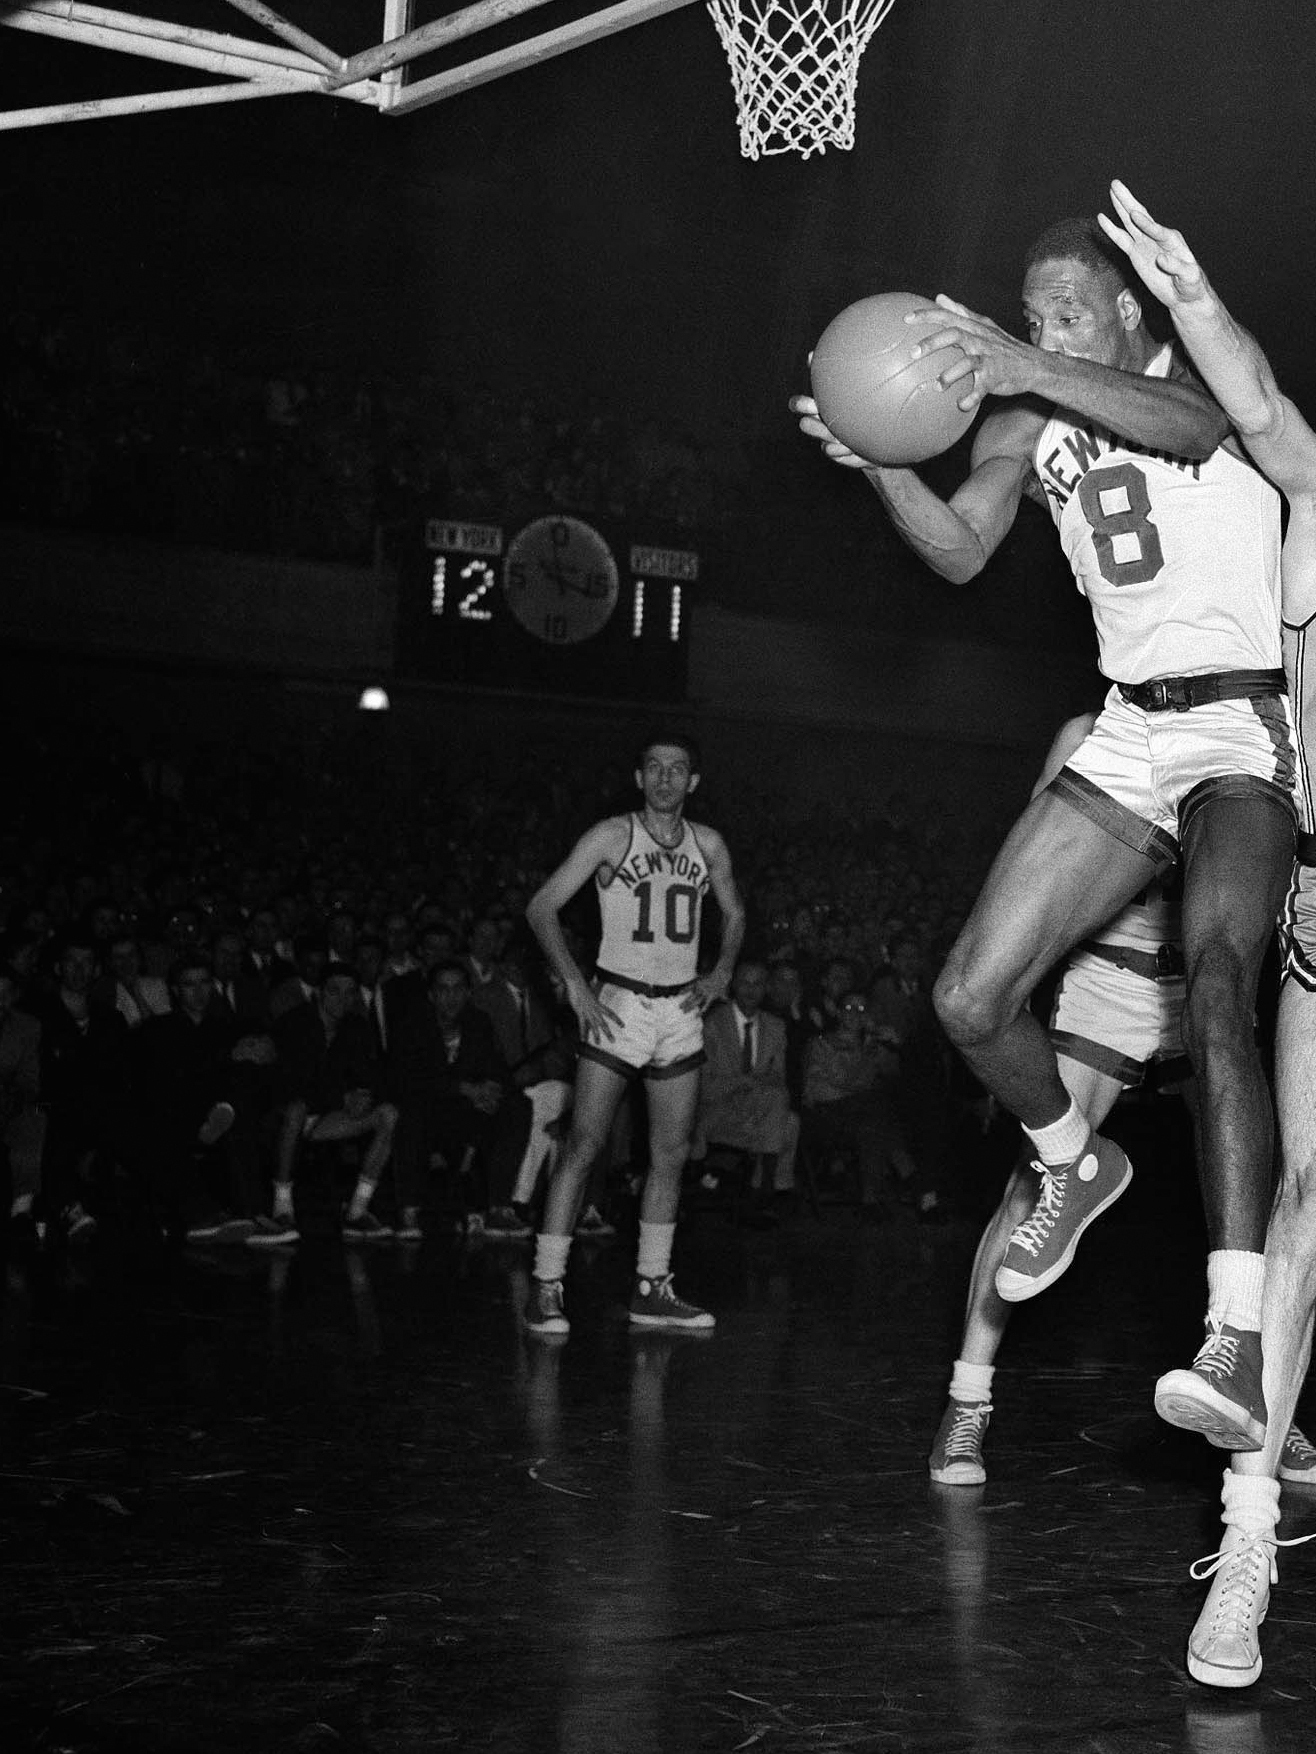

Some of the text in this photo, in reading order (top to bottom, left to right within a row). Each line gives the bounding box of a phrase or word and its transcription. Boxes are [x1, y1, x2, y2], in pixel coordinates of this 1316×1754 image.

[1077, 462, 1165, 587] 8
[431, 555, 496, 620] 12
[631, 579, 682, 642] 11
[617, 851, 663, 889] NEW
[633, 881, 698, 943] 10
